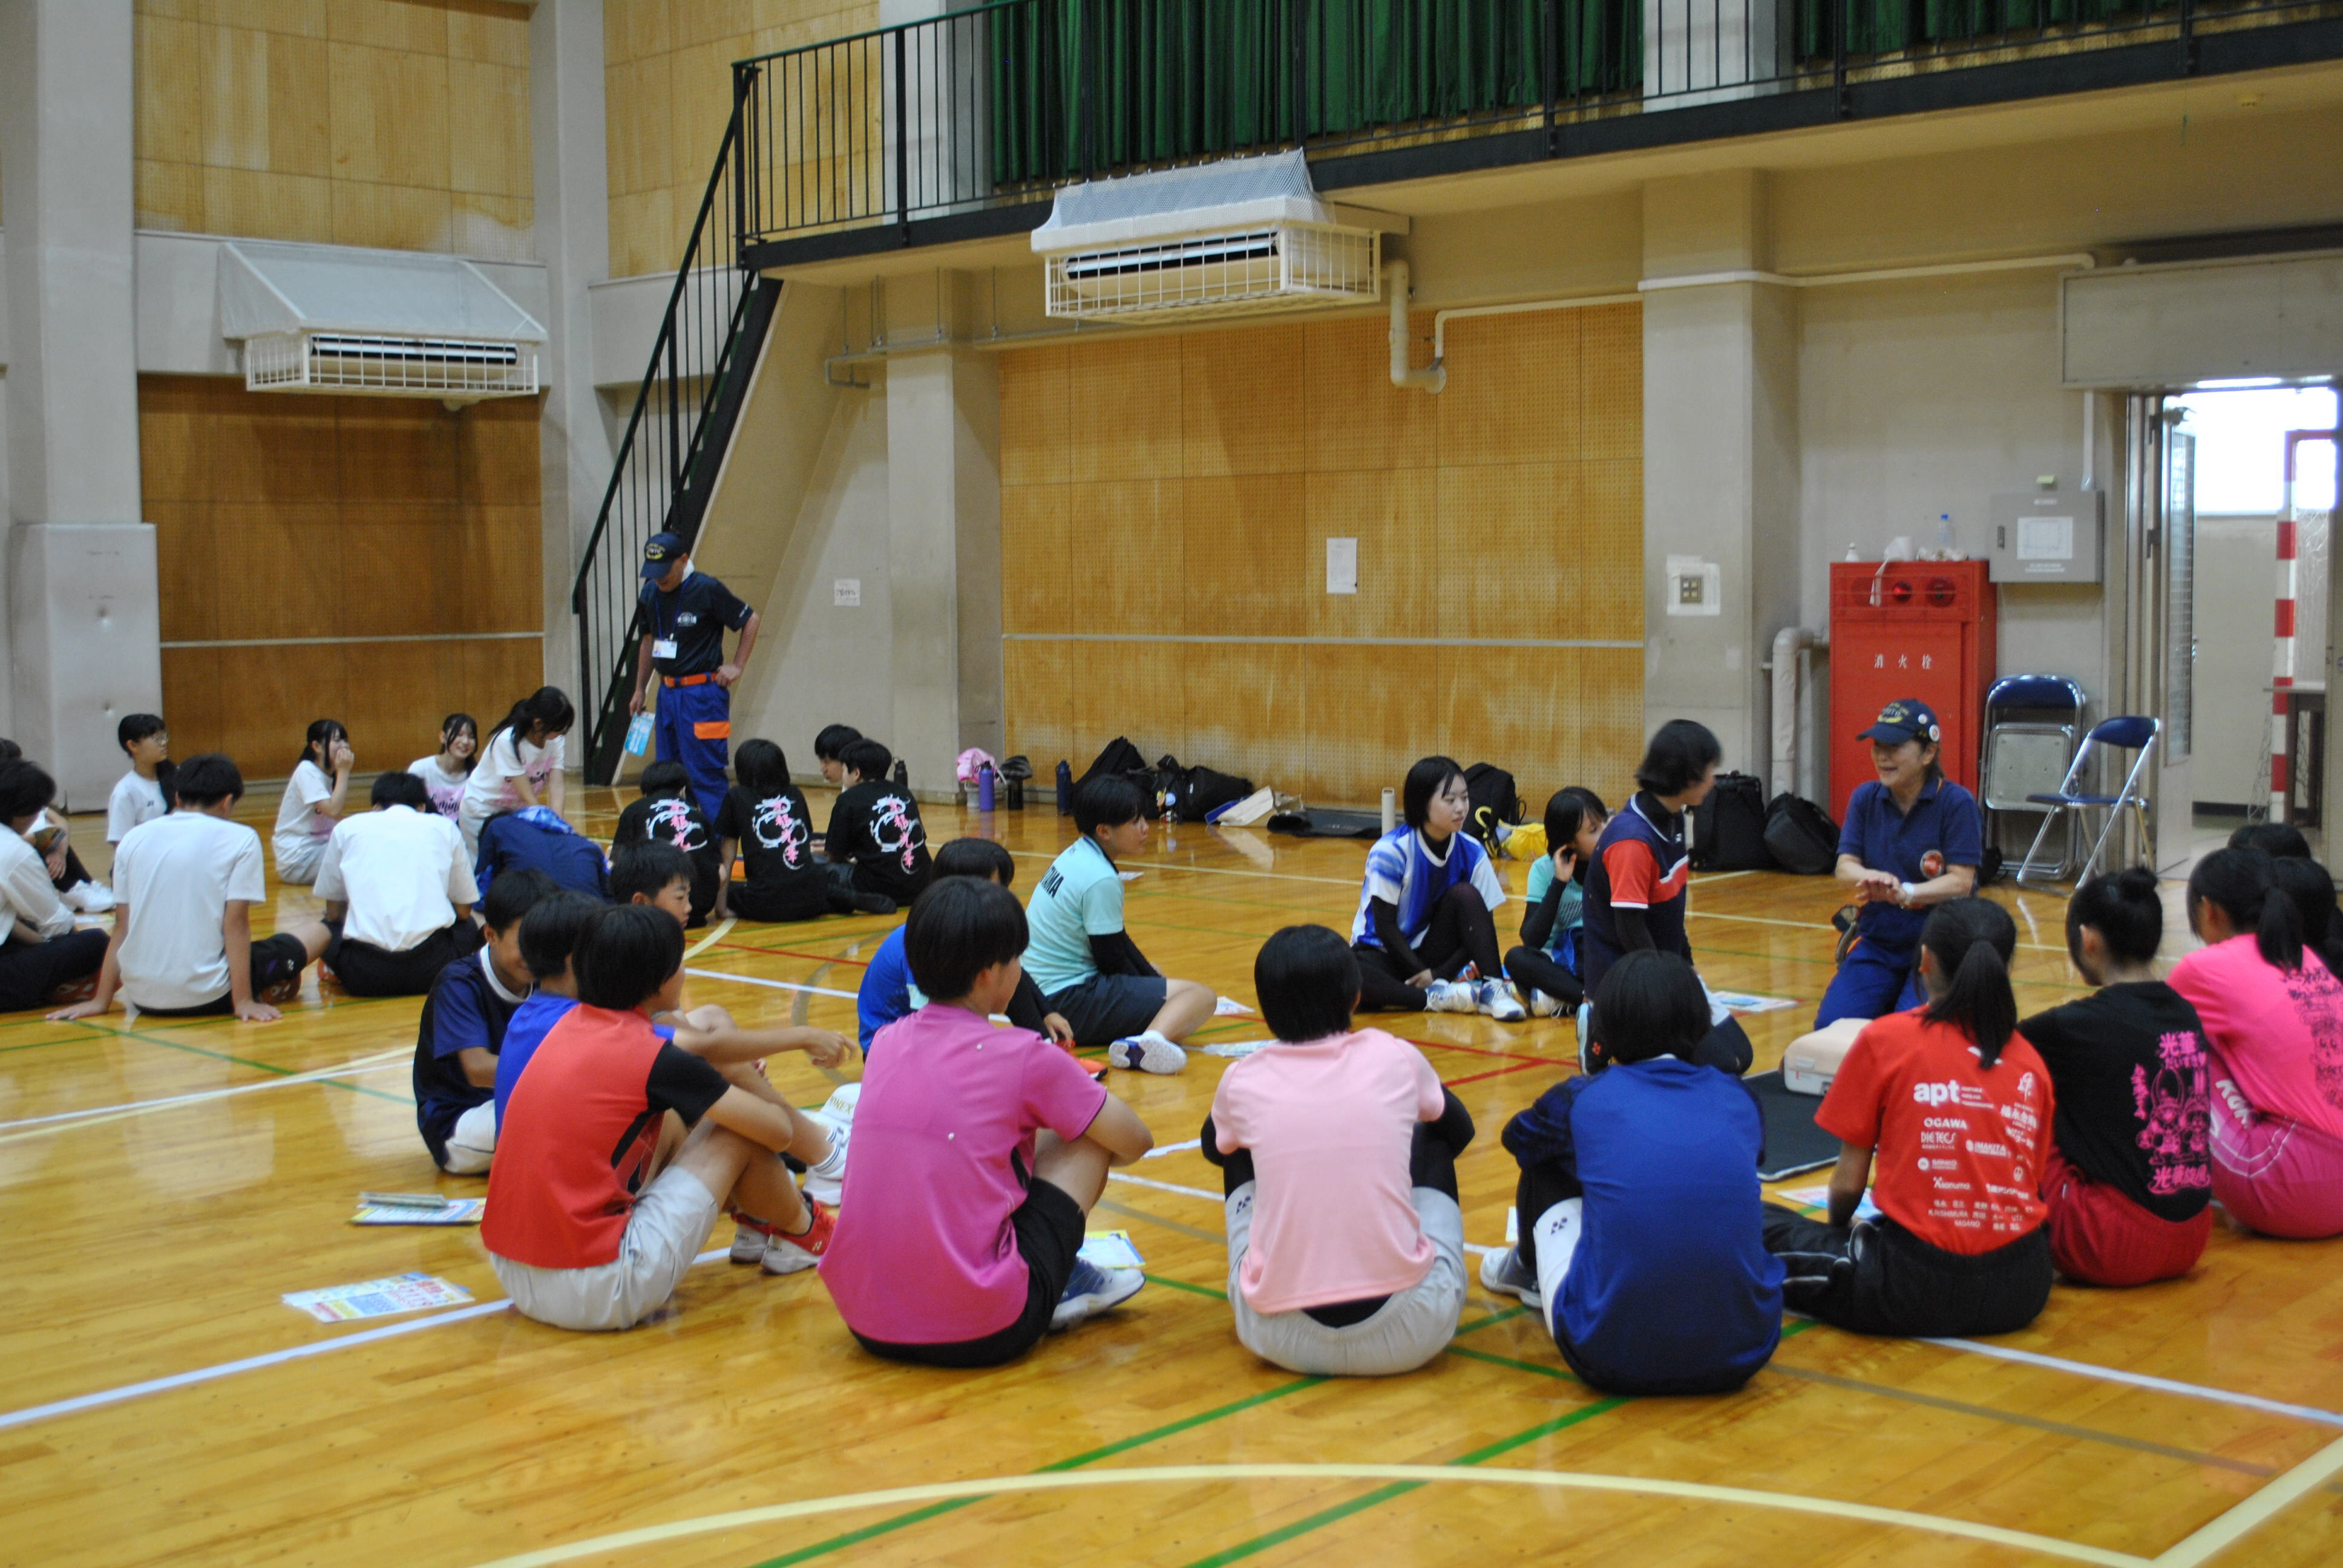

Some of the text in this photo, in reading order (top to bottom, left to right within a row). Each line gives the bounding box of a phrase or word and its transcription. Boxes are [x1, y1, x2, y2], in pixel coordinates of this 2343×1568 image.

[1875, 653, 1932, 669] 消火栓
[1913, 1079, 1960, 1106] apt
[1924, 1117, 1967, 1129] OGAWA
